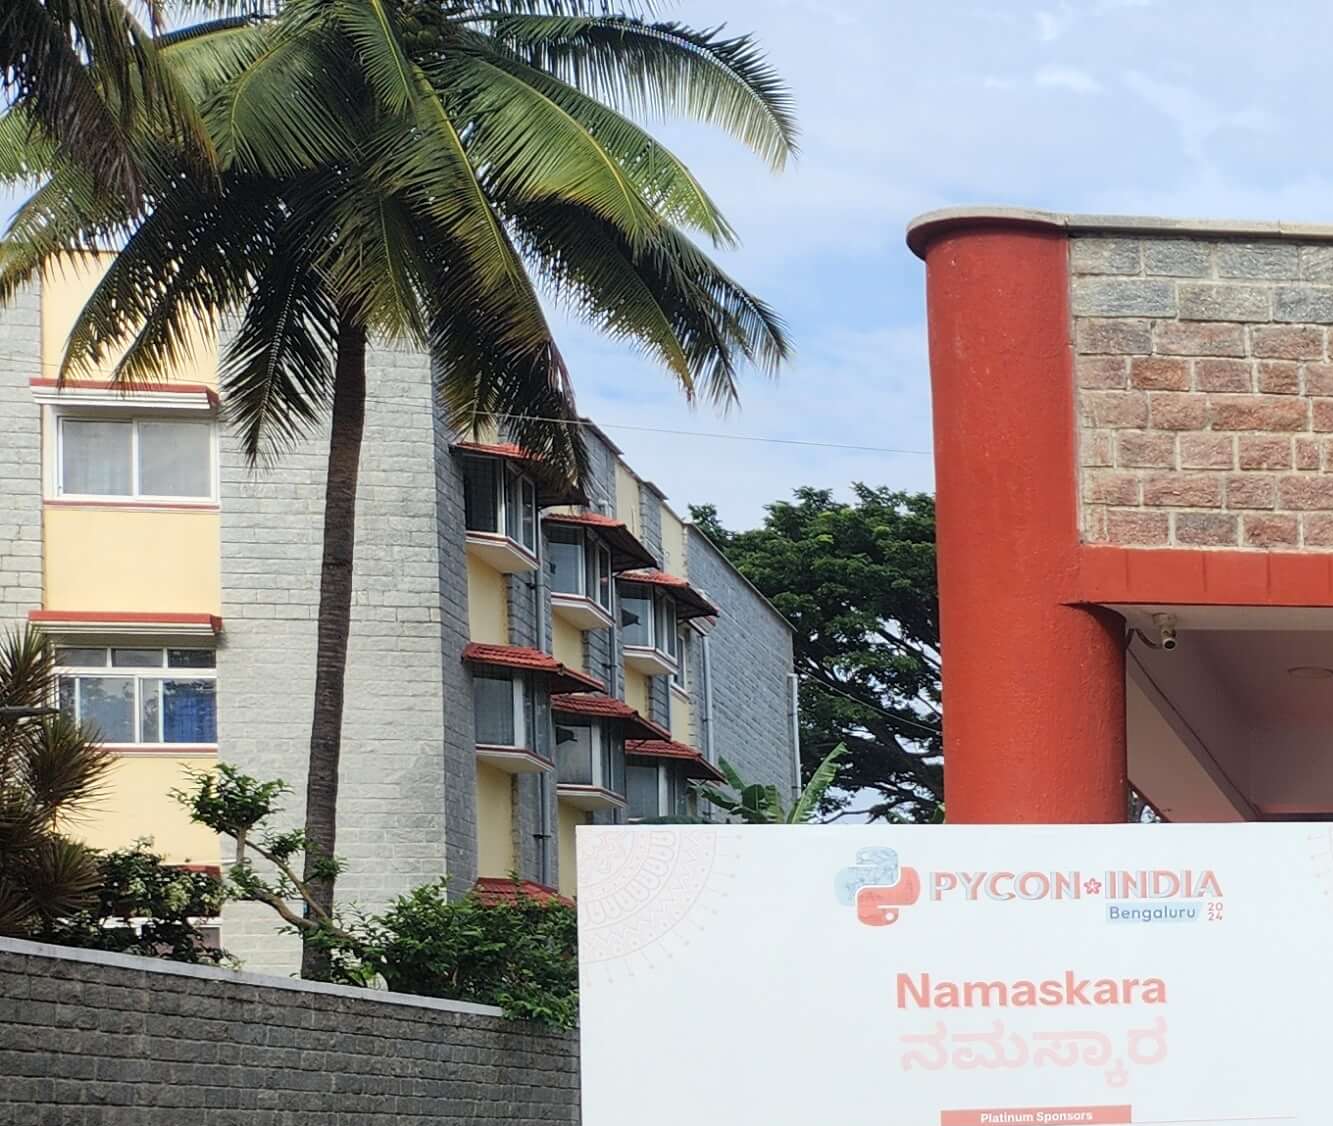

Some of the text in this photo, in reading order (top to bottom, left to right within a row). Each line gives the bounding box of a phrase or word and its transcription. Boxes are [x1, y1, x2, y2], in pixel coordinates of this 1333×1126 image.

[929, 870, 1223, 900] PYCON INDIA
[1109, 905, 1196, 922] Bengaluru
[896, 971, 1167, 1008] Namaskara
[980, 1110, 1093, 1123] Platinum Sponsors
